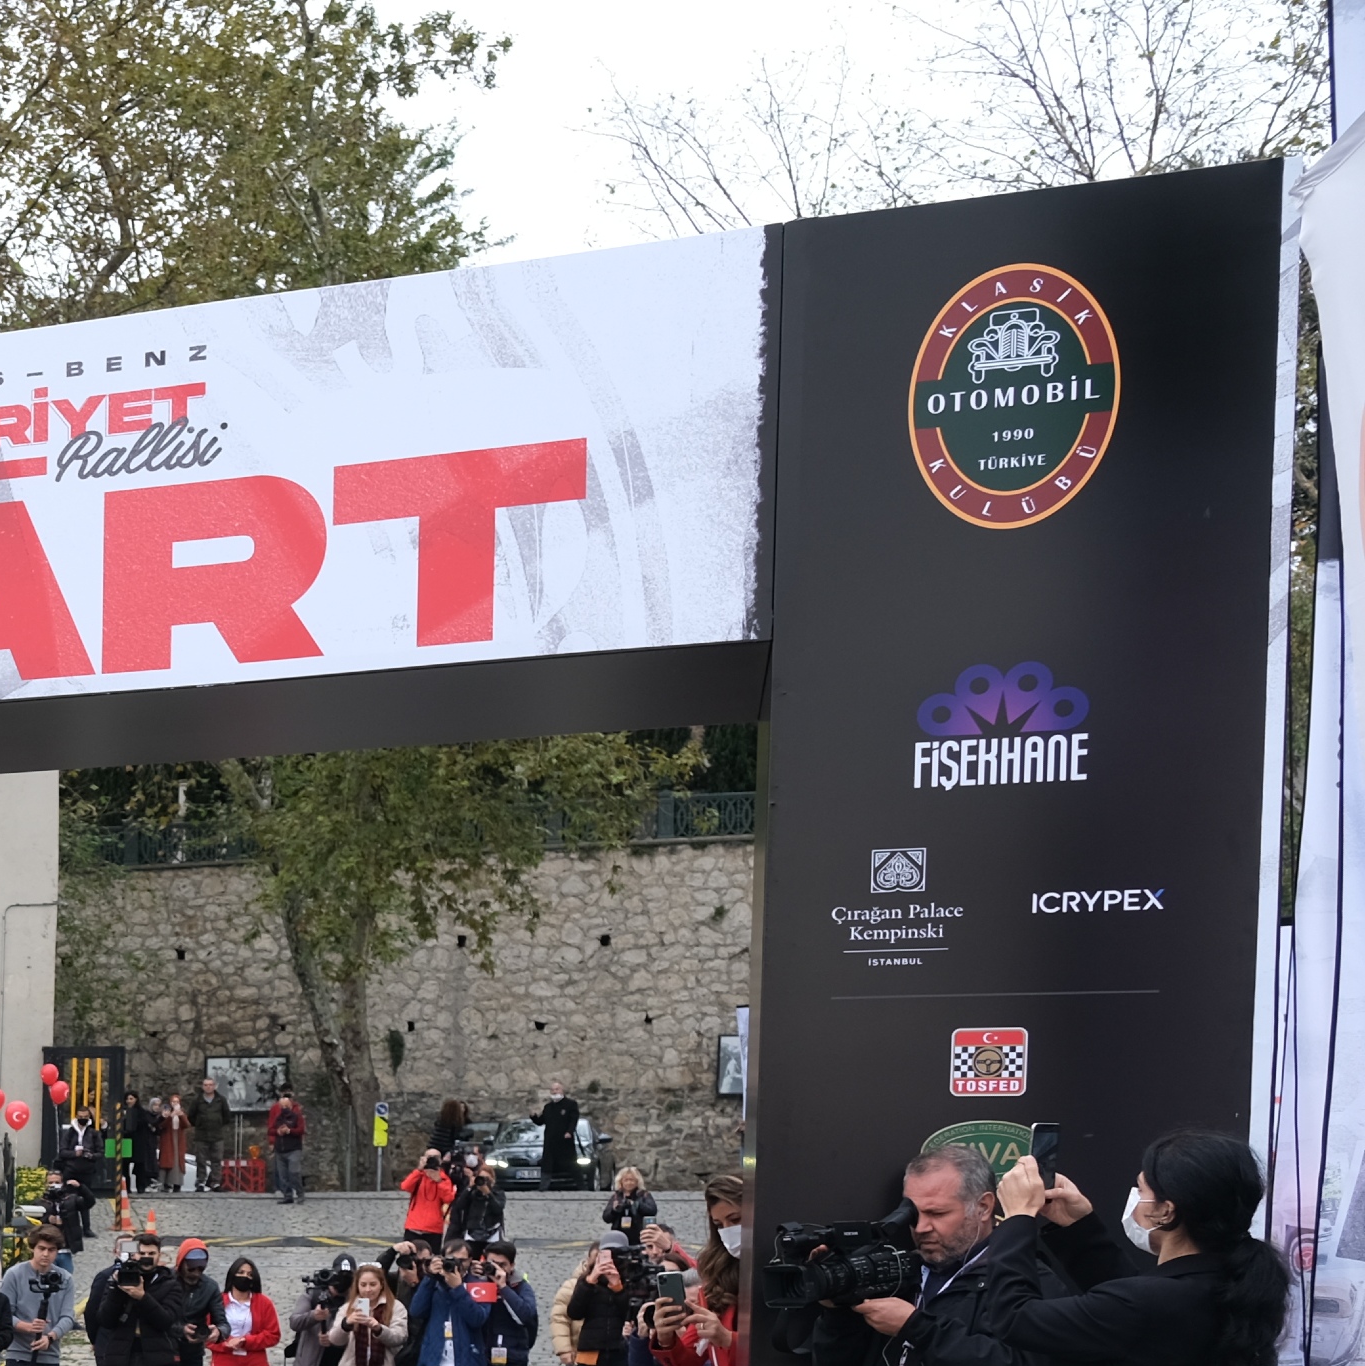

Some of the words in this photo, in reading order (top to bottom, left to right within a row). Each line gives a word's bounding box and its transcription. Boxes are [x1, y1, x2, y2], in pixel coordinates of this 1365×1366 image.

[927, 375, 1100, 415] OTOMOBİL
[992, 428, 1034, 442] 1990
[55, 417, 228, 483] Rallisi
[978, 453, 1047, 471] TÜRKİYE
[929, 445, 1097, 516] KULÜBÜ
[1032, 888, 1165, 913] ICRYPEX
[831, 905, 902, 925] Çırağan
[908, 903, 964, 919] Palace
[849, 923, 944, 943] Kempinski
[868, 956, 923, 966] İSTANBUL
[955, 1079, 1020, 1092] TOSFED
